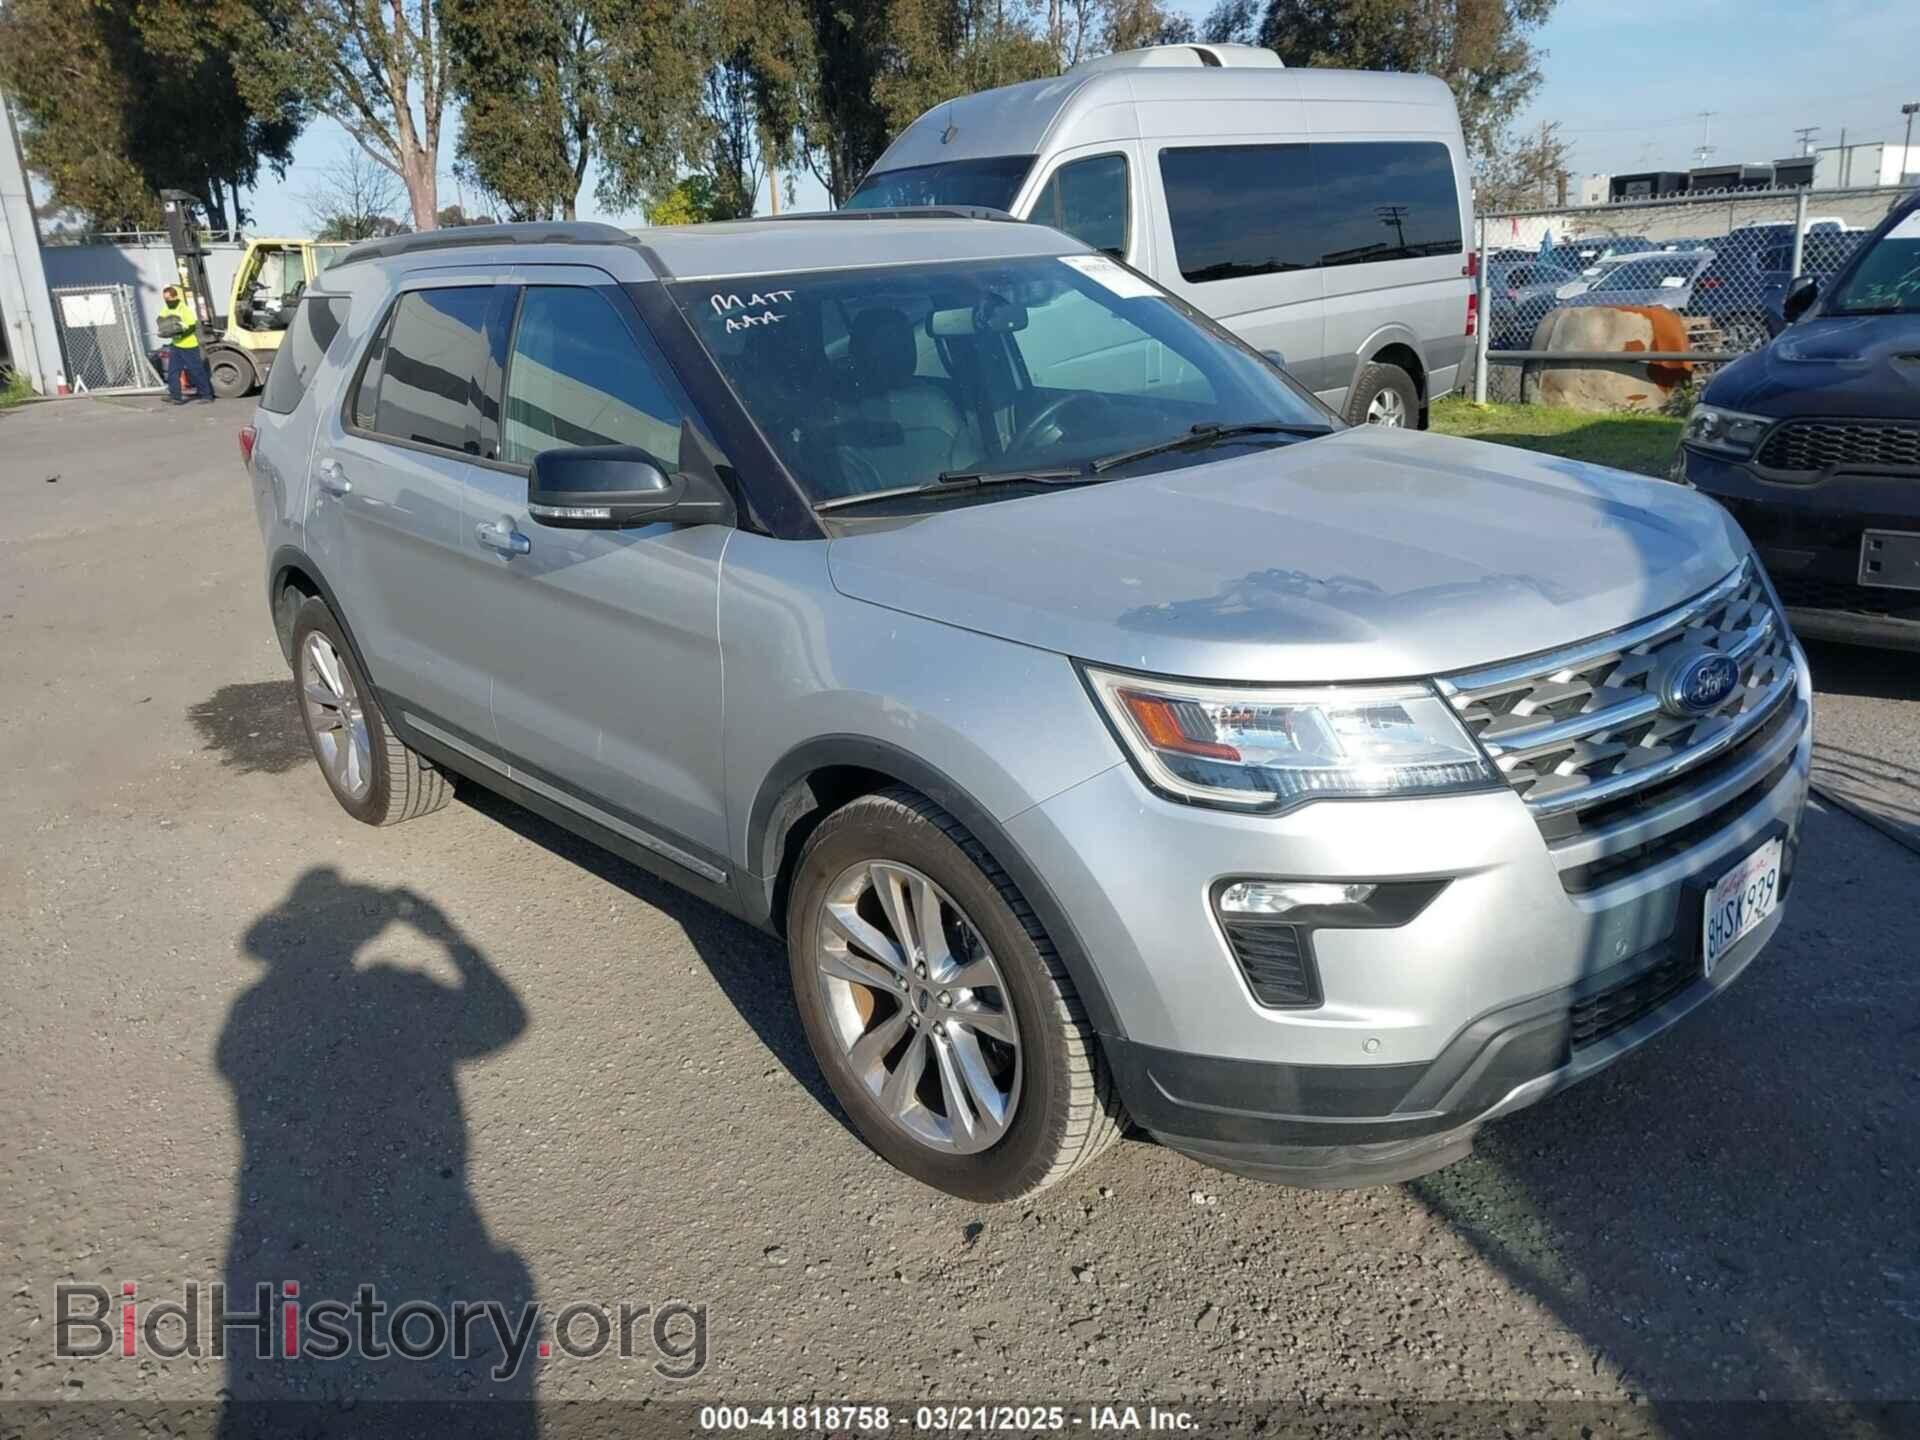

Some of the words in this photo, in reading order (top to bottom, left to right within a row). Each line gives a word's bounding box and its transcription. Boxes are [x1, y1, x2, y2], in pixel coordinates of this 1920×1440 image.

[711, 291, 796, 315] MATT
[1692, 665, 1729, 699] Ford
[1707, 867, 1776, 959] 8HSK939
